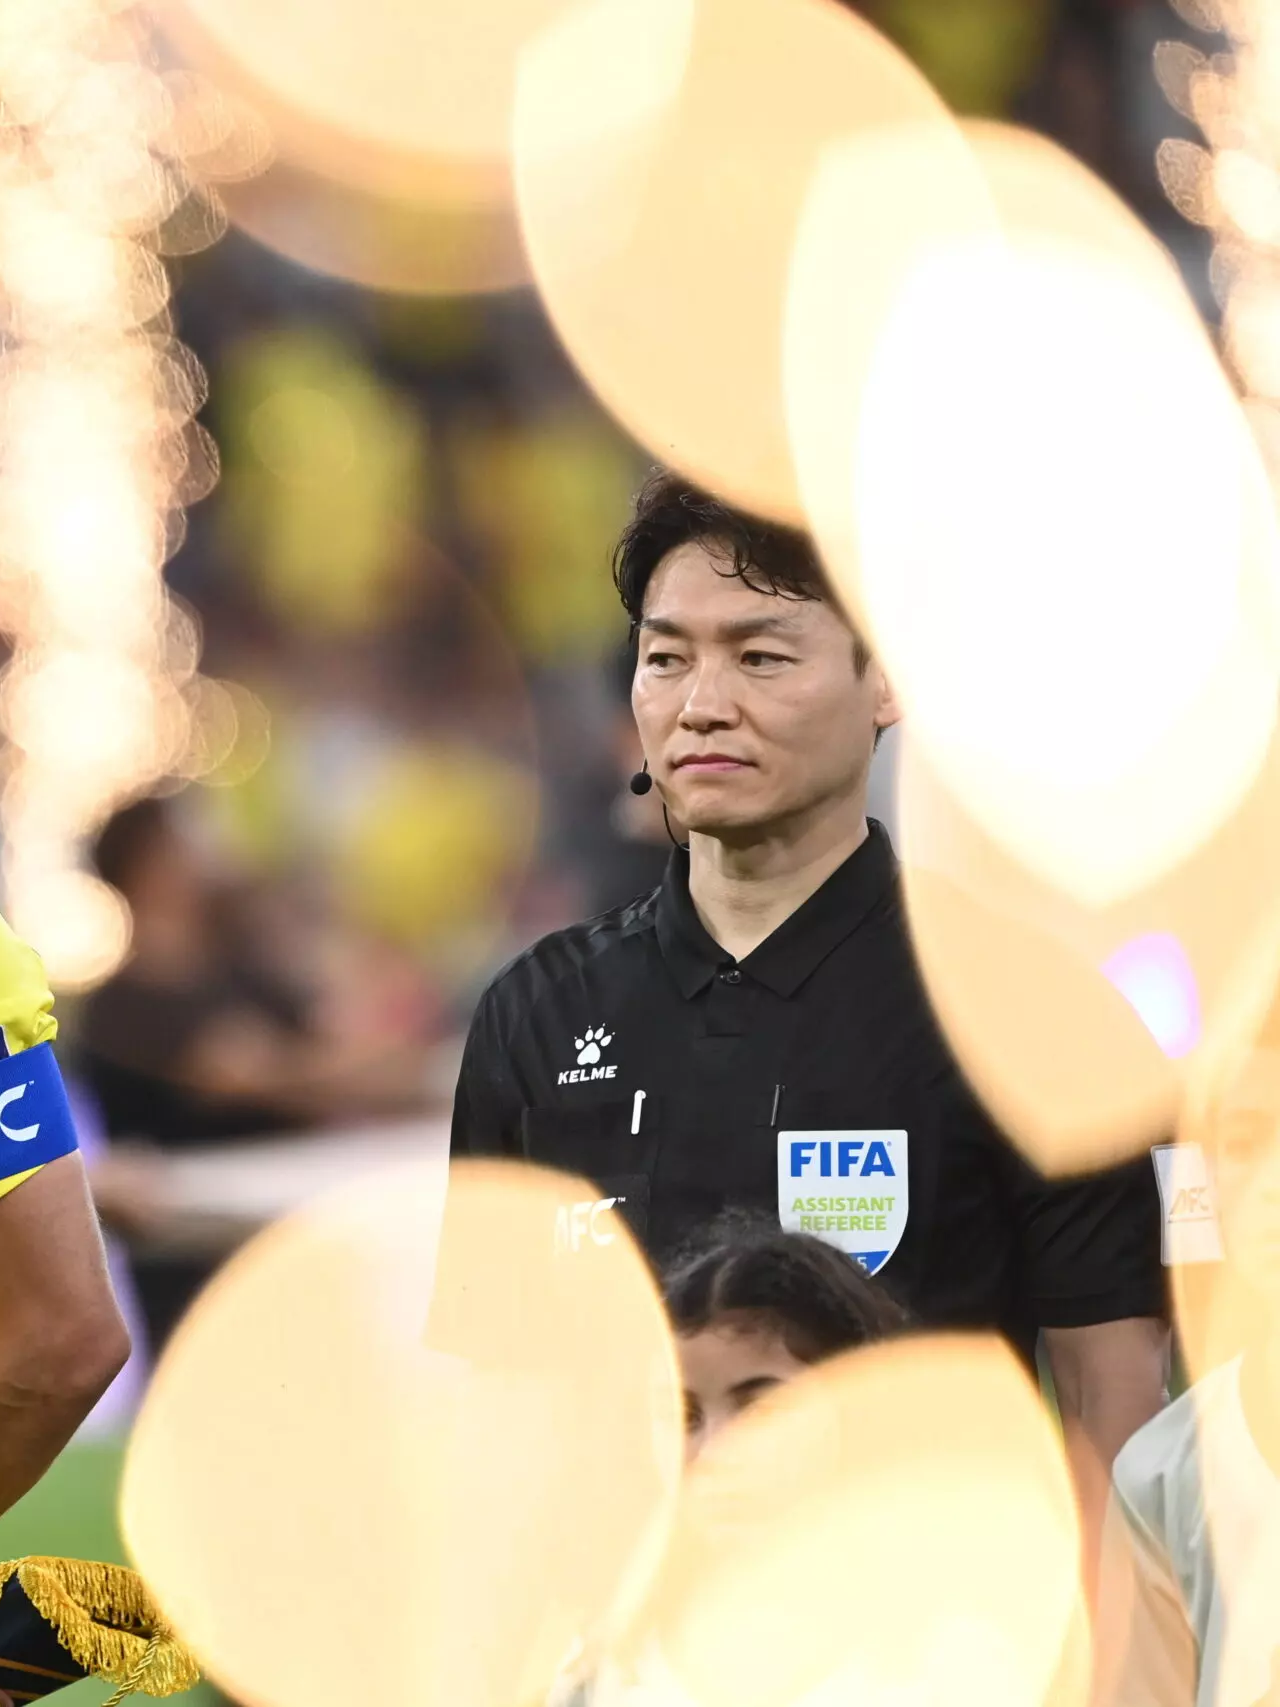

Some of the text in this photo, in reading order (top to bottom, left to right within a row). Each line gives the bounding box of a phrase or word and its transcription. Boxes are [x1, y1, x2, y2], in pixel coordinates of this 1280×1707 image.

[557, 1065, 618, 1085] KELME
[790, 1141, 896, 1177] FIFA
[791, 1196, 896, 1213] ASSISTANT
[799, 1214, 888, 1232] REFEREE
